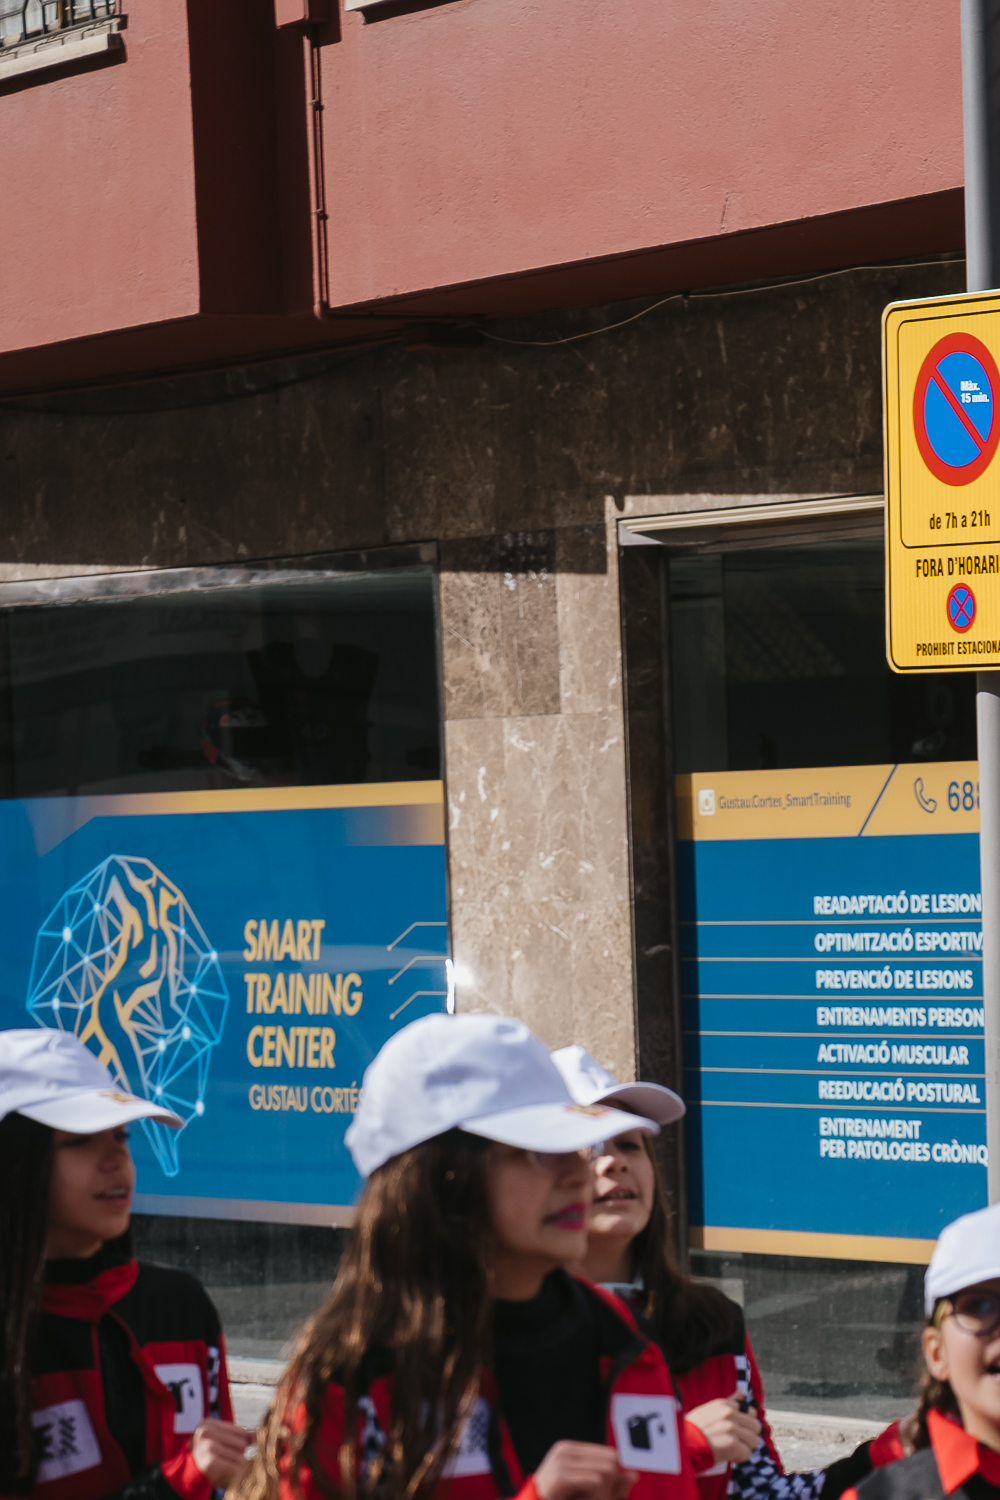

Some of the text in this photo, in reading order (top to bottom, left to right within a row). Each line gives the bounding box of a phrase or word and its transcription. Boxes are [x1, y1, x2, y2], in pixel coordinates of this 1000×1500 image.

[960, 391, 990, 403] 15 min.
[929, 510, 991, 530] de 7h a 21h
[915, 557, 944, 578] FORA
[915, 641, 955, 657] PROHIBIT
[947, 780, 980, 812] 68
[813, 890, 909, 916] READAPTACIÓ
[910, 894, 930, 915] DE
[243, 918, 326, 962] SMART
[814, 927, 914, 952] OPTIMITZACIÓ
[815, 965, 974, 990] PREVENCIÓ DE LESIONS
[243, 972, 363, 1016] TRAINING
[816, 1006, 927, 1027] ENTRENAMENTS
[246, 1025, 336, 1069] CENTER
[817, 1040, 891, 1064] ACTIVACIÓ
[891, 1044, 970, 1066] MUSCULAR
[249, 1083, 309, 1113] GUSTAU
[818, 1077, 981, 1104] REEDUCACIÓ POSTURAL
[819, 1117, 922, 1140] ENTRENAMENT
[819, 1138, 846, 1159] PER
[847, 1140, 931, 1163] PATOLOGIES
